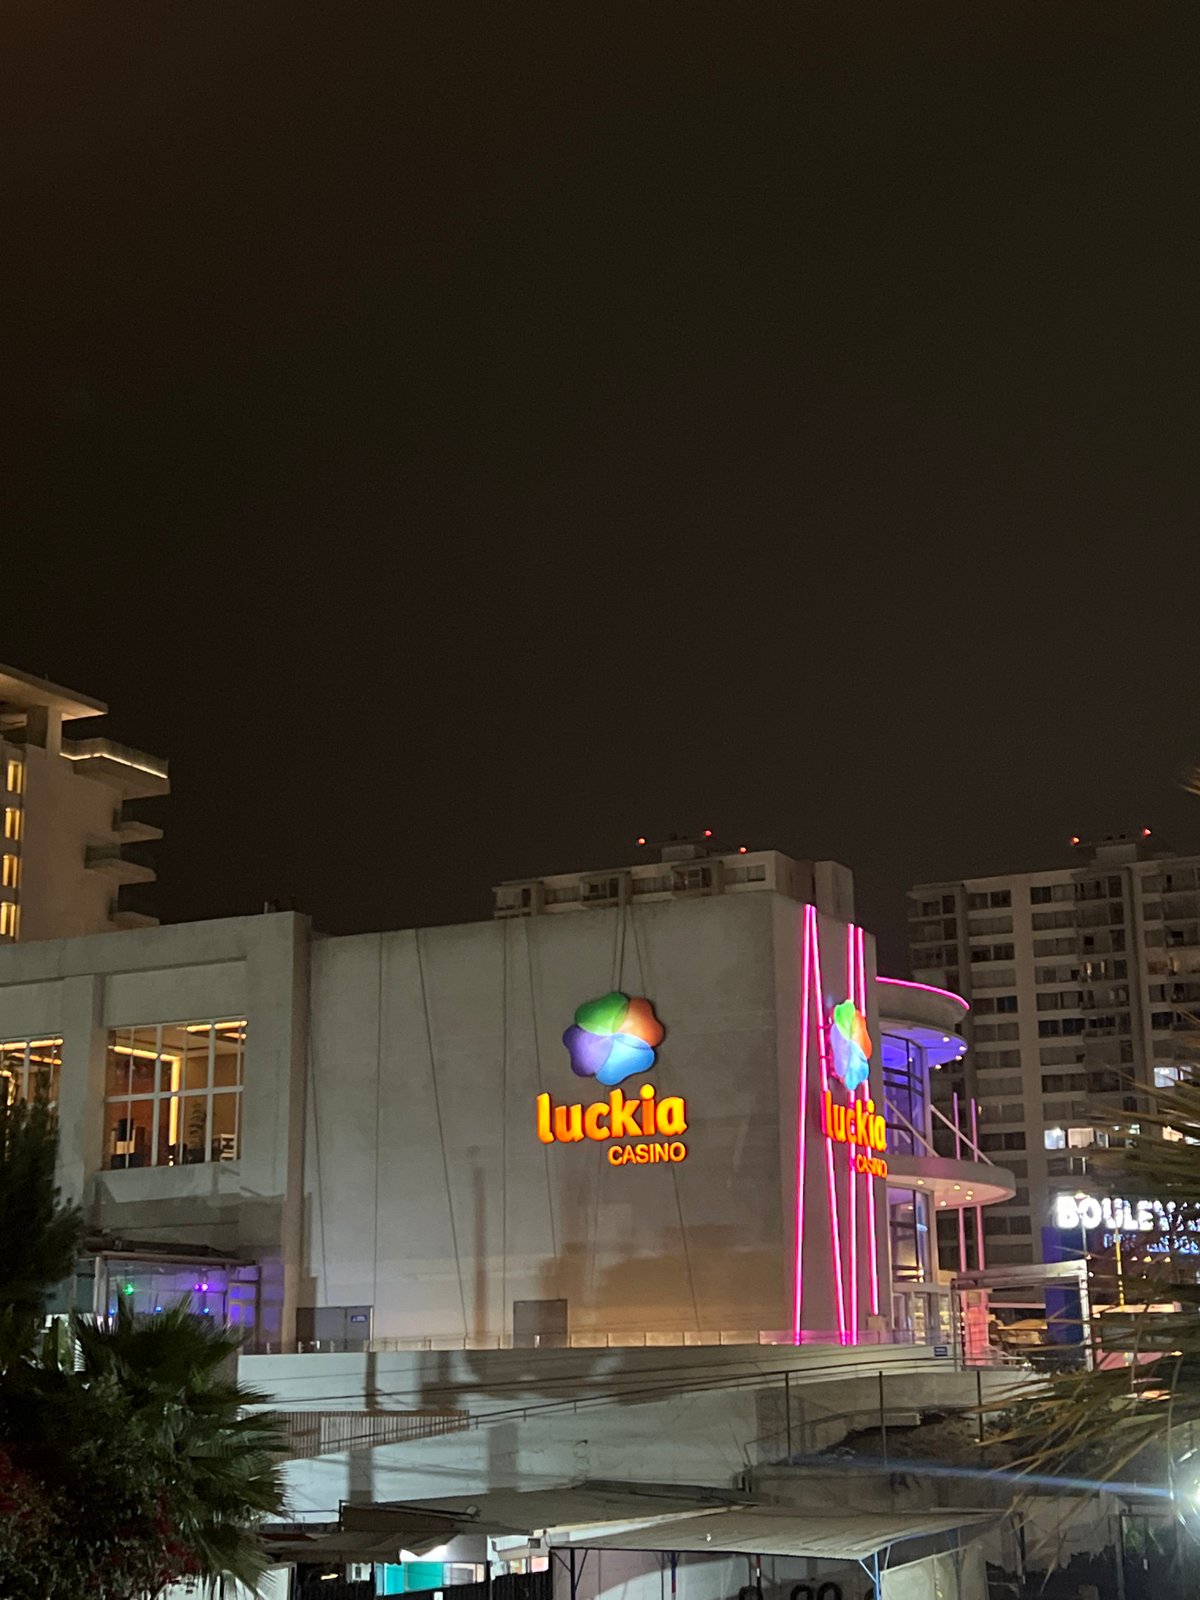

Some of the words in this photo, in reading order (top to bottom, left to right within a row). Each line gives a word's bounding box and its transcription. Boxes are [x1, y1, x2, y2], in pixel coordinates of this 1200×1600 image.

[536, 1083, 688, 1144] luckia
[823, 1089, 887, 1153] luckia
[607, 1141, 687, 1166] CASINO
